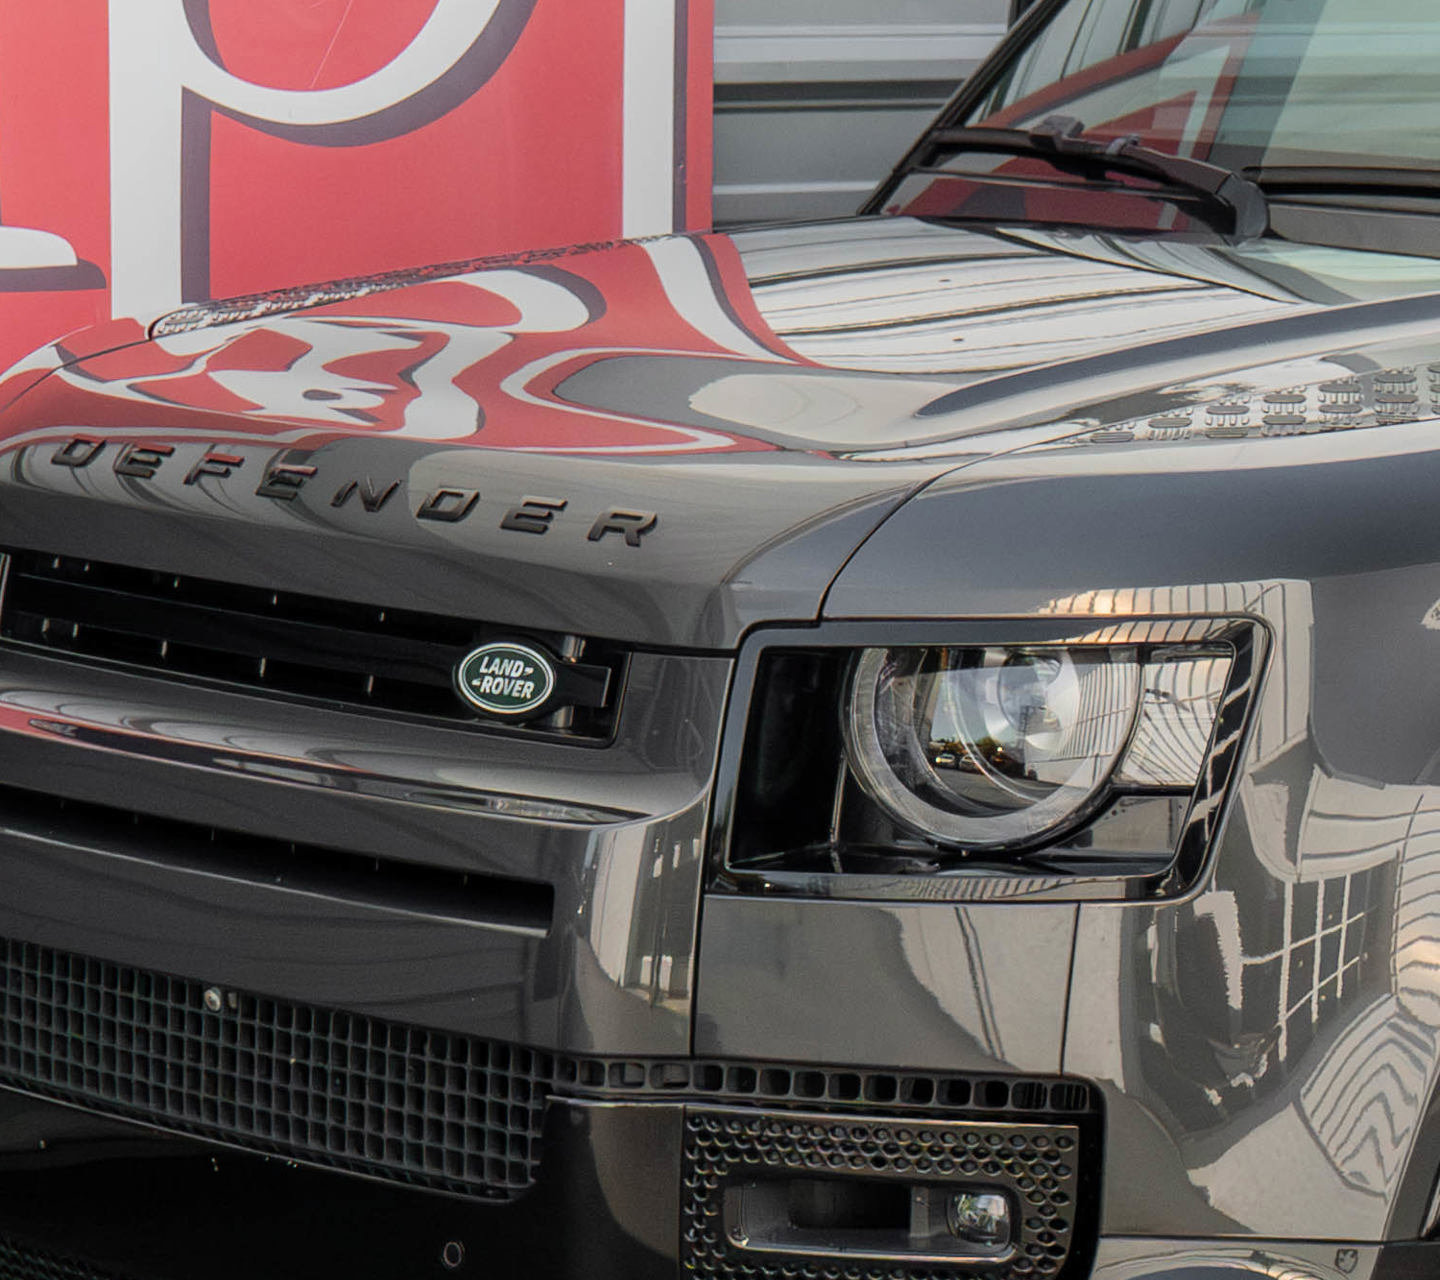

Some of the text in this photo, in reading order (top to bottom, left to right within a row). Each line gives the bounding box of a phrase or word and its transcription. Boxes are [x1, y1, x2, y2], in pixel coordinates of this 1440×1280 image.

[50, 432, 659, 548] DEFENDER
[479, 656, 525, 678] LAND
[479, 675, 535, 699] ROVER
